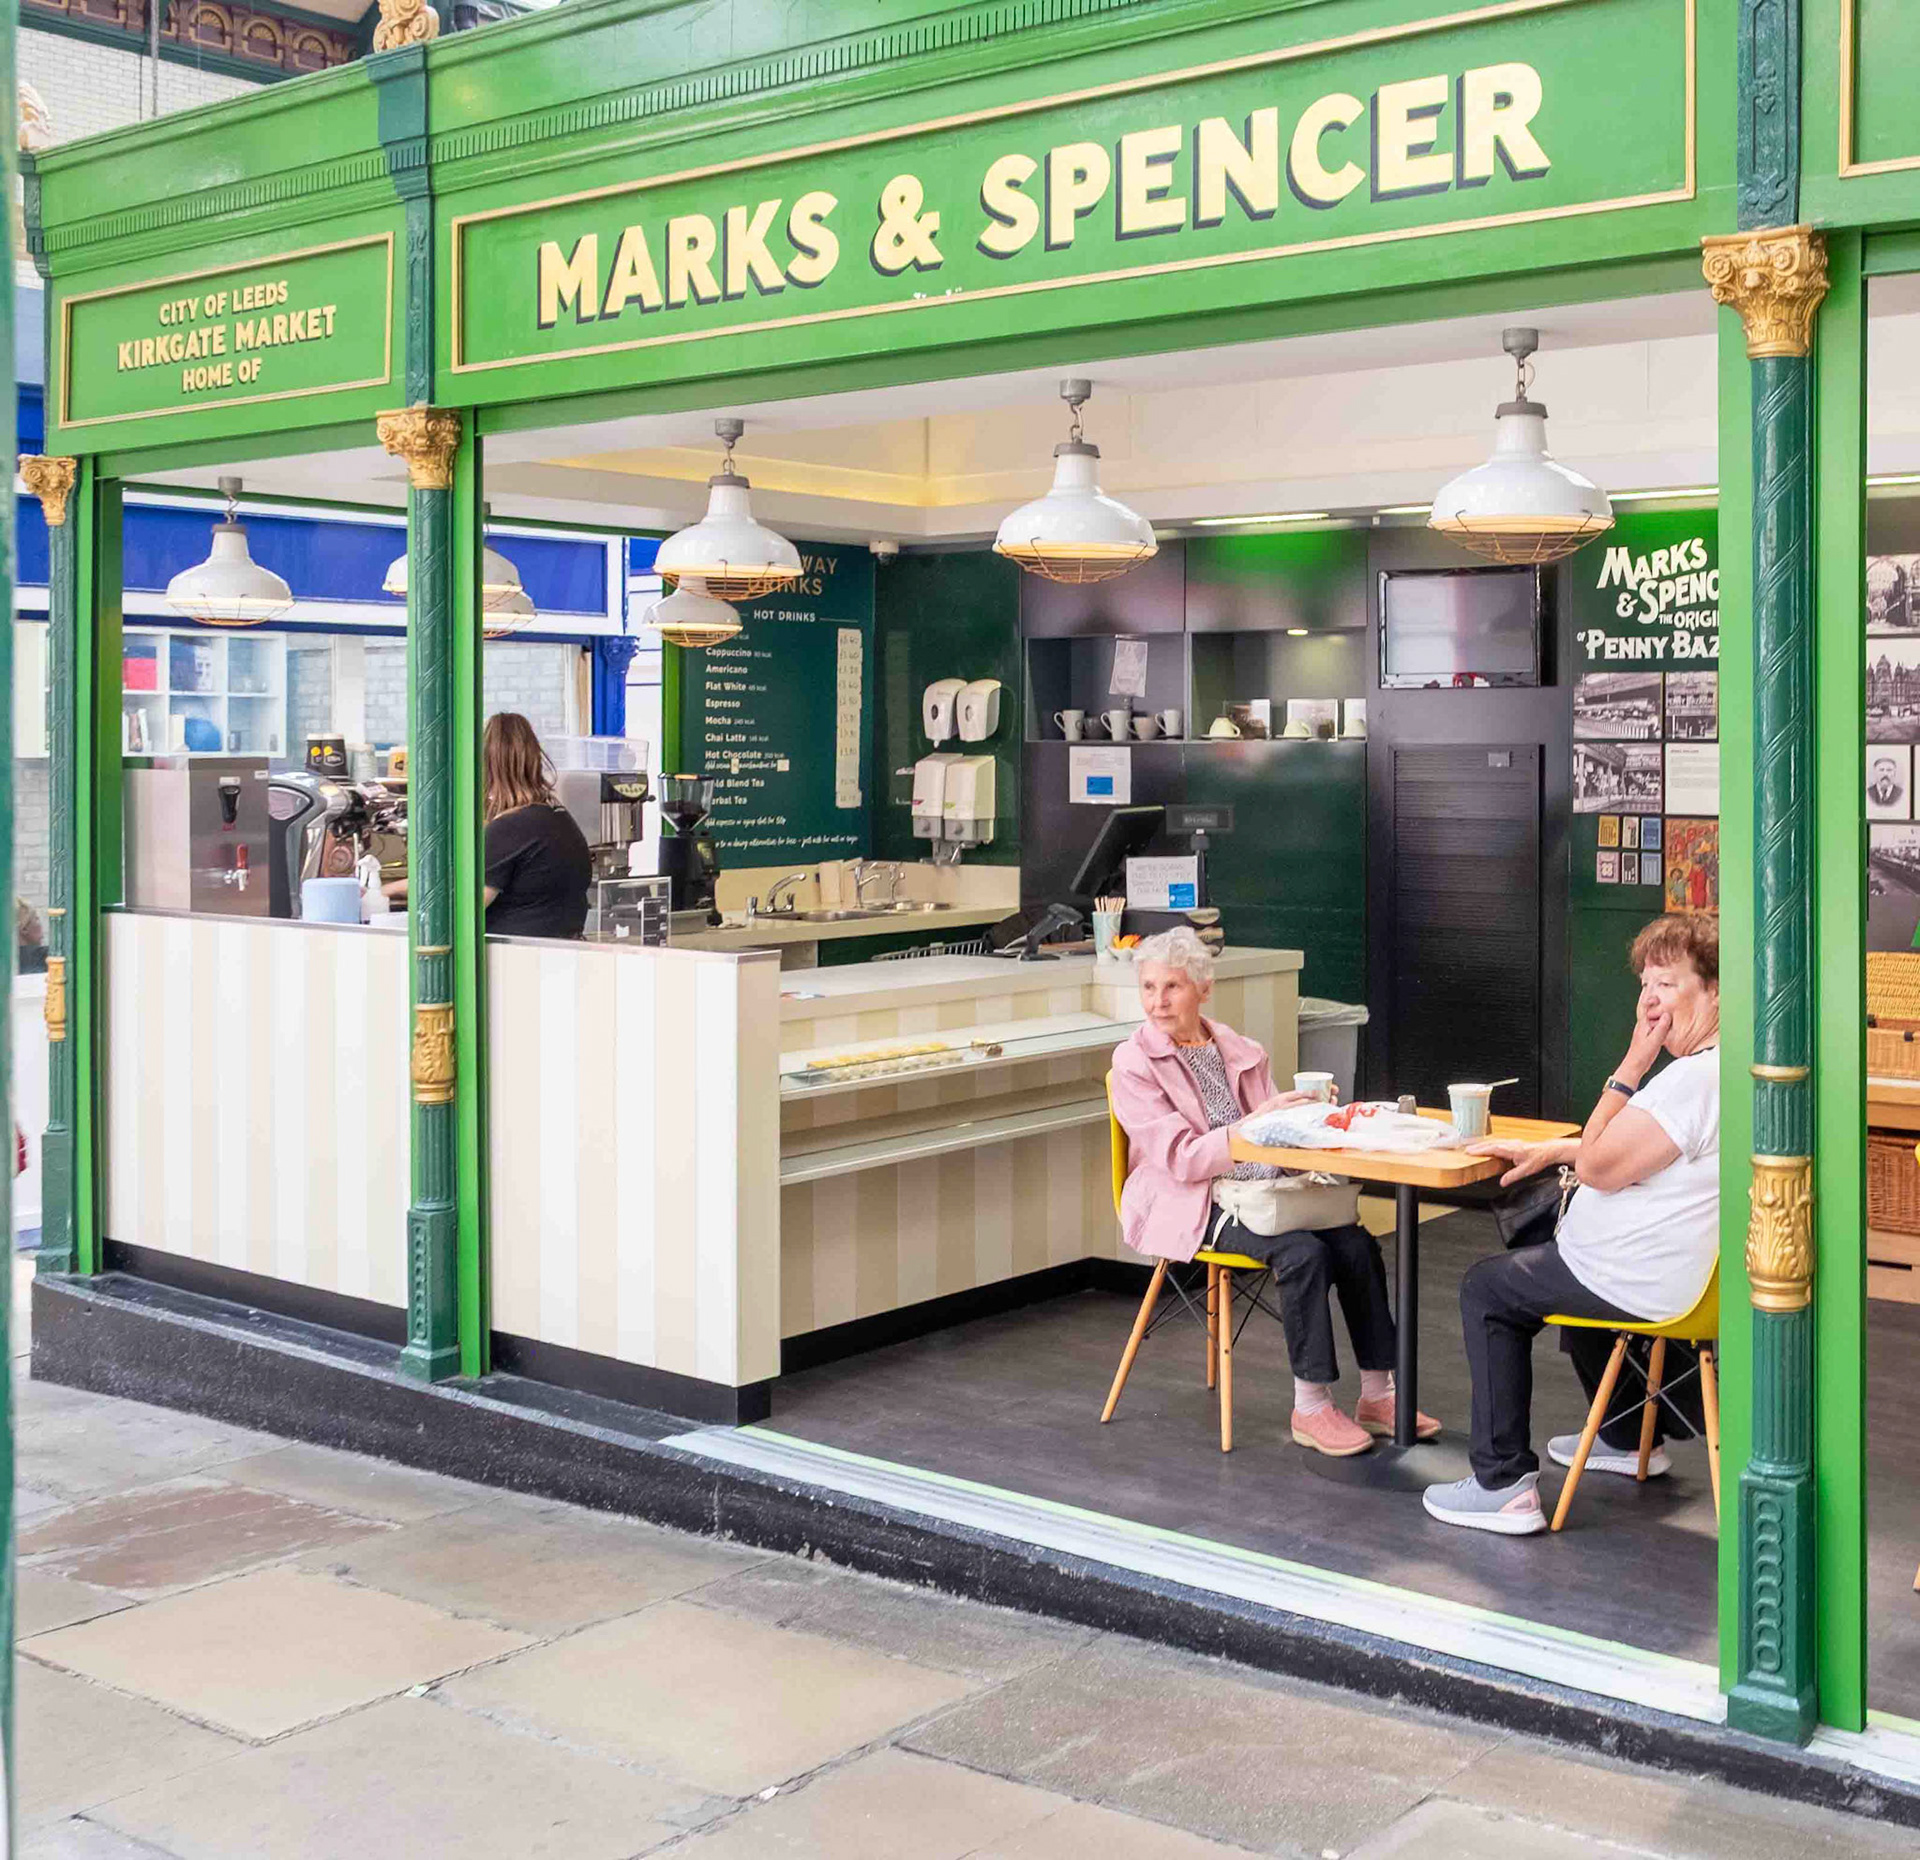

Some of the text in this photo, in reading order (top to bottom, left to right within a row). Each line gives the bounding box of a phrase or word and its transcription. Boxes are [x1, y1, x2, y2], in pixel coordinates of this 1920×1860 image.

[539, 62, 1551, 329] MARKS & SPENCER
[159, 280, 288, 326] CITY OF LEEDS
[117, 304, 337, 371] KIRKGATE MARKET
[181, 358, 262, 393] HOME OF
[1596, 537, 1708, 591] MARKS
[1616, 569, 1719, 624] & SPENC
[753, 609, 816, 623] HOT DRINKS
[1674, 610, 1719, 631] ORIGI
[1585, 629, 1670, 660] PENNY
[1671, 629, 1719, 659] BAZ
[705, 646, 752, 658] Cappuccino
[705, 664, 748, 674] Americano
[705, 681, 722, 691] Flat
[723, 681, 747, 691] White
[705, 698, 741, 709] Espresso
[705, 716, 732, 725] Mocha
[705, 733, 724, 743] Chai
[725, 733, 747, 743] Latte
[705, 750, 720, 759] Hot
[722, 749, 763, 760] Chocolate
[726, 779, 749, 788] Blend
[752, 778, 765, 788] Tea
[711, 795, 748, 805] erbal Tea
